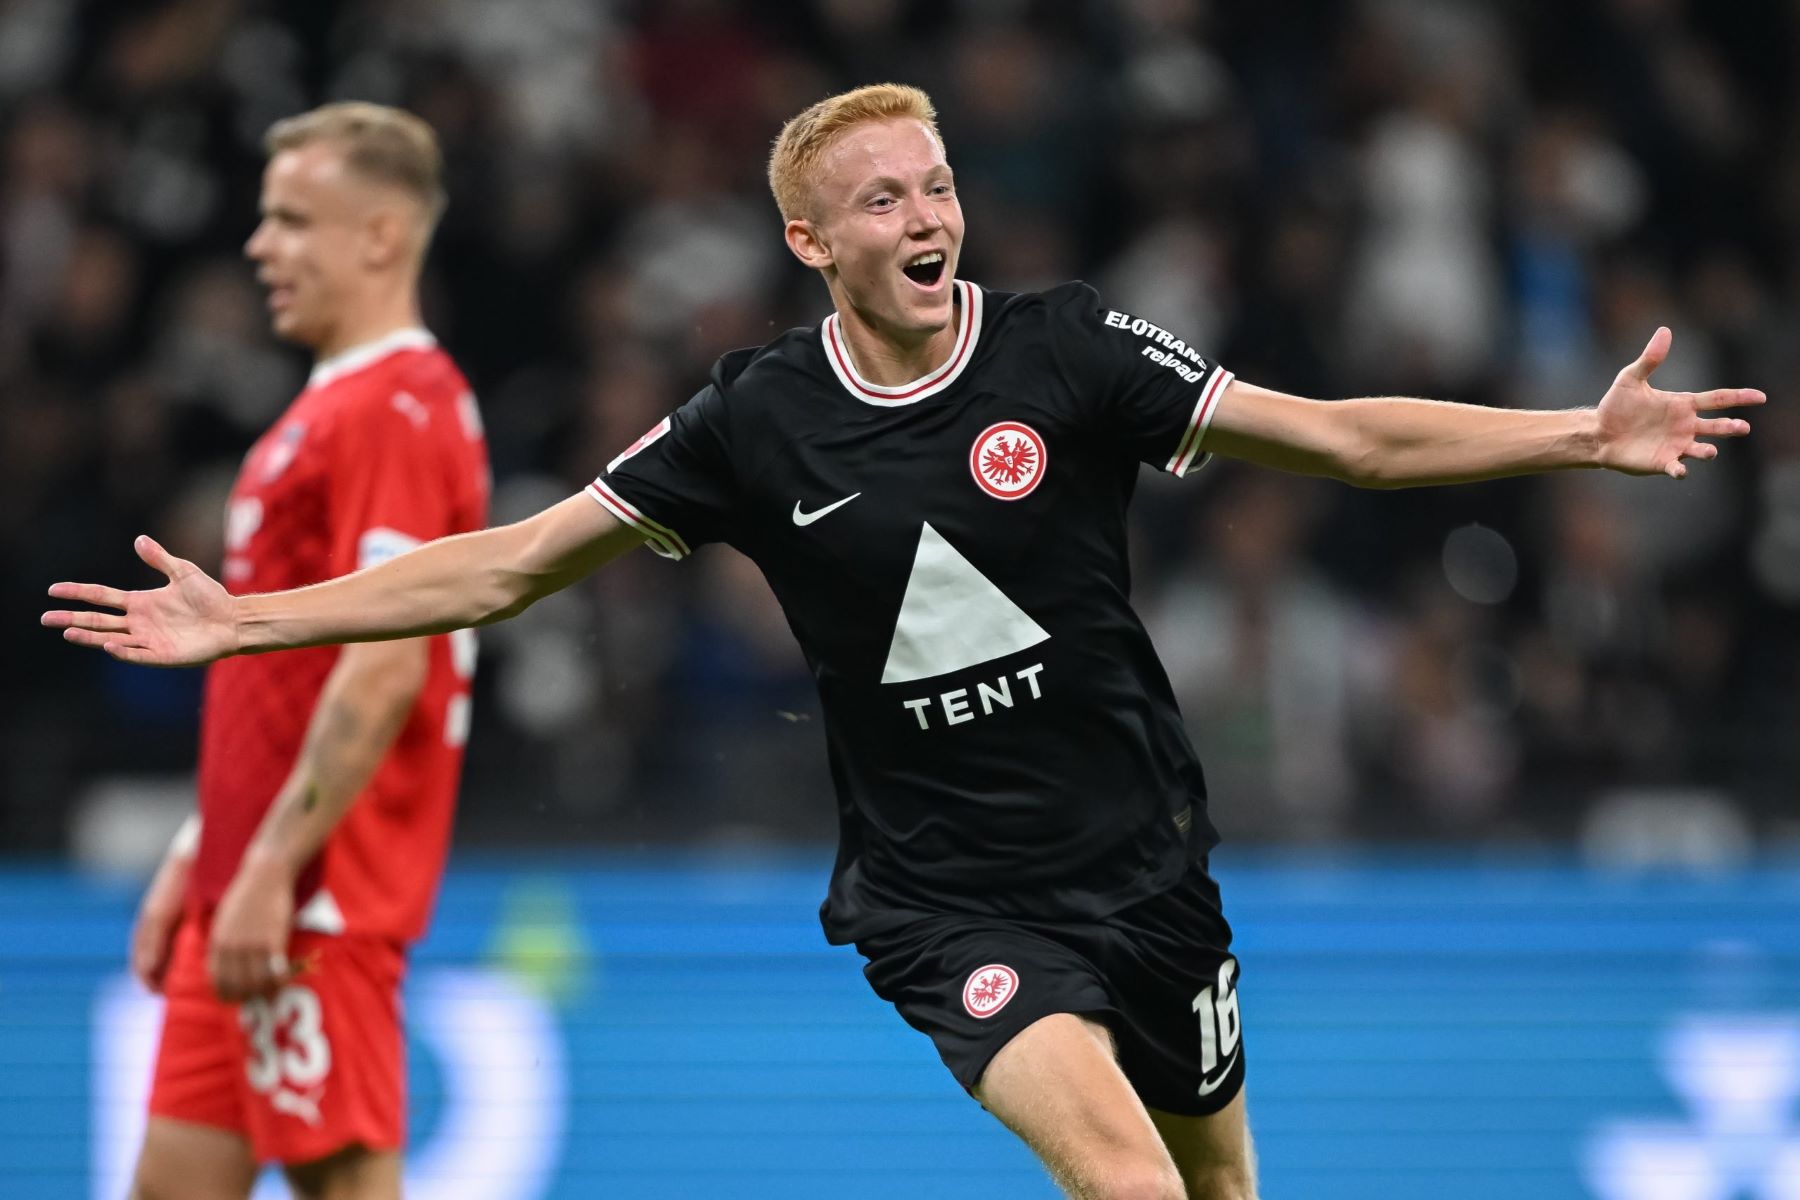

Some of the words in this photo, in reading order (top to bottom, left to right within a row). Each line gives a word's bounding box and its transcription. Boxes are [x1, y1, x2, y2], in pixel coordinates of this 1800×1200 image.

[1141, 345, 1204, 383] reload
[903, 662, 1044, 730] TENT
[239, 984, 332, 1092] 33
[1192, 958, 1240, 1074] 16
